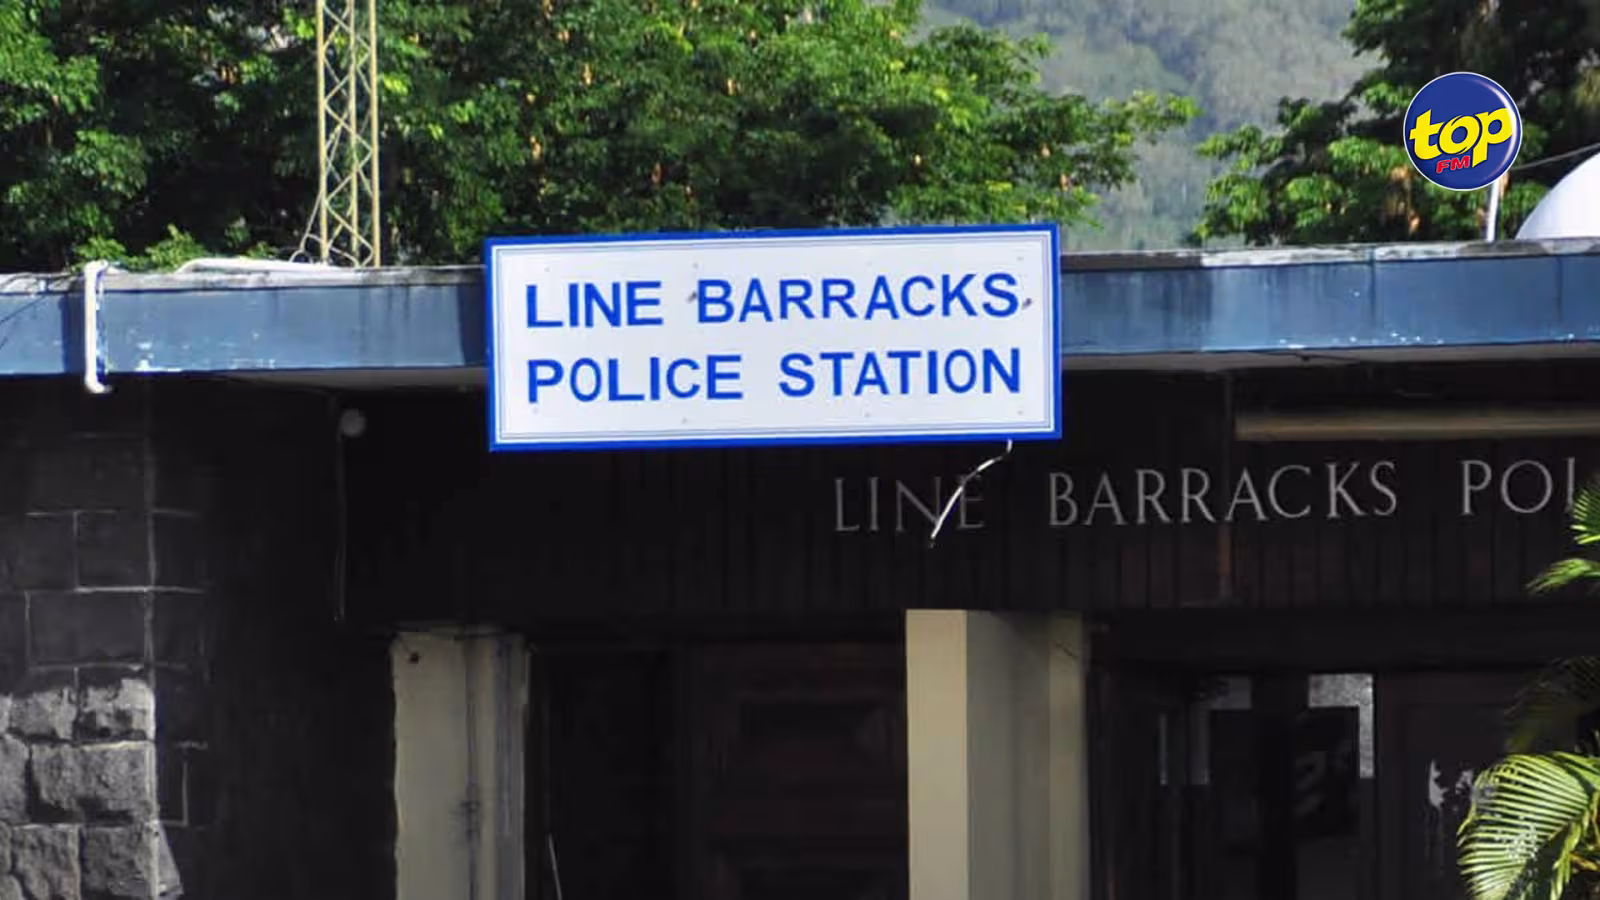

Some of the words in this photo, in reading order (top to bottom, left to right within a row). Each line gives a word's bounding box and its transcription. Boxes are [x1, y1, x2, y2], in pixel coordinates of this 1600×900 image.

[526, 281, 664, 329] LINE
[697, 273, 1020, 324] BARRACKS
[527, 356, 743, 404] POLICE
[779, 348, 1022, 398] STATION
[834, 475, 985, 533] LINE
[1049, 461, 1398, 526] BARRACKS
